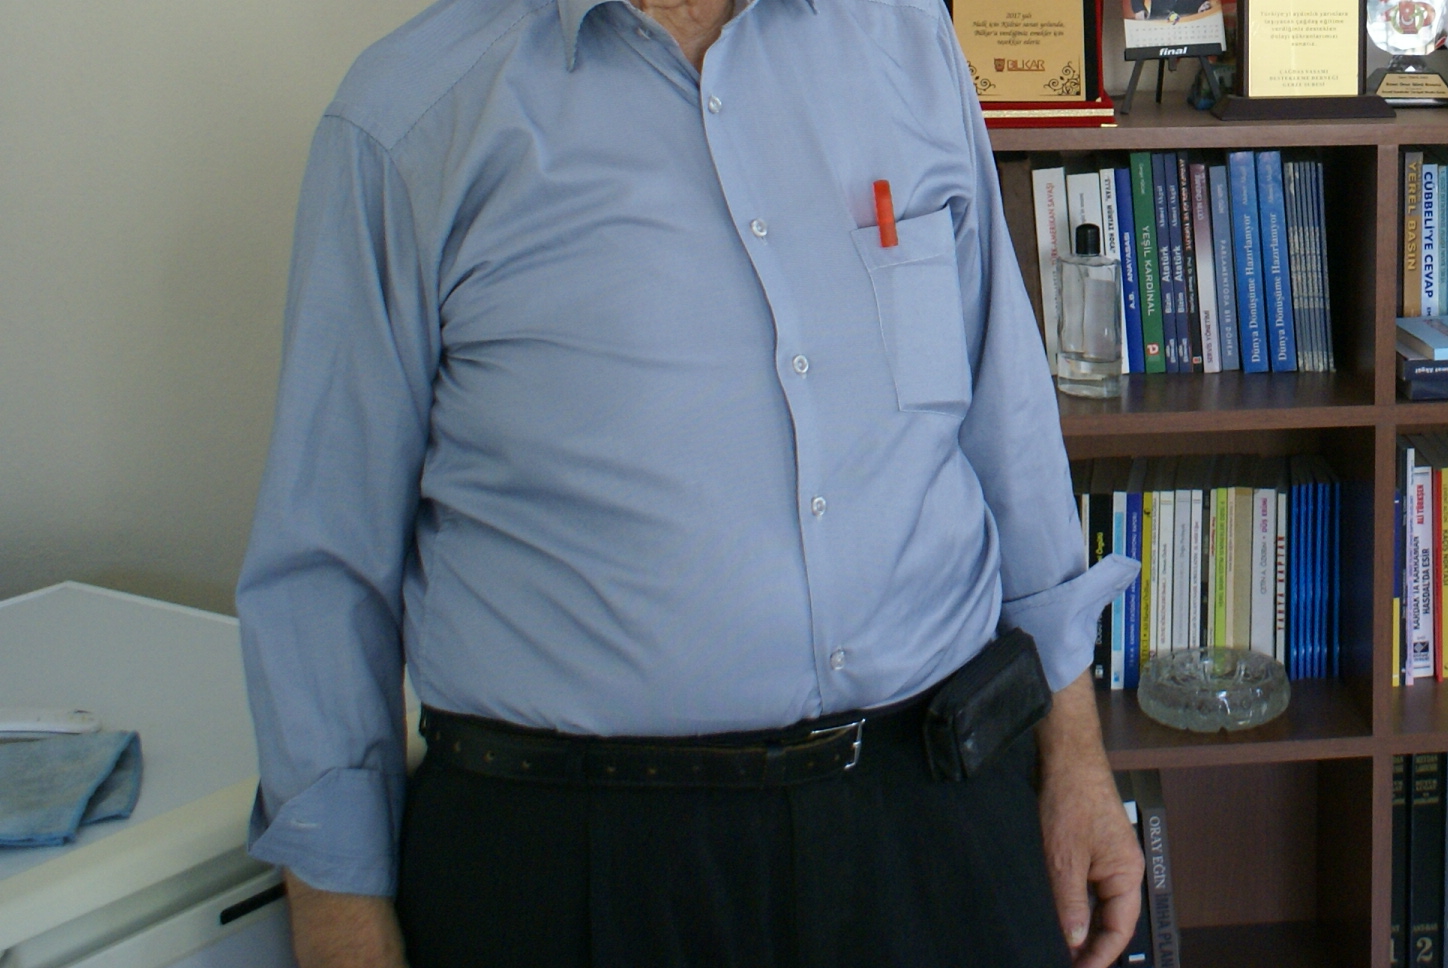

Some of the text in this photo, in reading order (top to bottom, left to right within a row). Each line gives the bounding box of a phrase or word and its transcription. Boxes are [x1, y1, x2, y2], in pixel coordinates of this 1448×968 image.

[1159, 46, 1188, 56] final
[1407, 162, 1416, 270] YEREL BASIN
[1424, 171, 1435, 298] CÜBBELİ'YE CEVAP
[1124, 232, 1134, 282] ANAYASASI
[1141, 226, 1155, 316] YEŞİL KARDİNAL
[1161, 246, 1172, 313] Bizim Atatürk
[1173, 245, 1185, 313] Bizim Atatürk
[1243, 214, 1262, 362] Dünya Dönüşüme Hazırlanıyor
[1270, 212, 1288, 361] Dünya Dönüşüme Hazırlanıyor
[1204, 310, 1214, 363] SERVİS YÖNETİMİ
[1422, 548, 1430, 567] ESİR
[1148, 815, 1172, 929] ORAY EĞİN İMHA
[1416, 937, 1433, 963] 2
